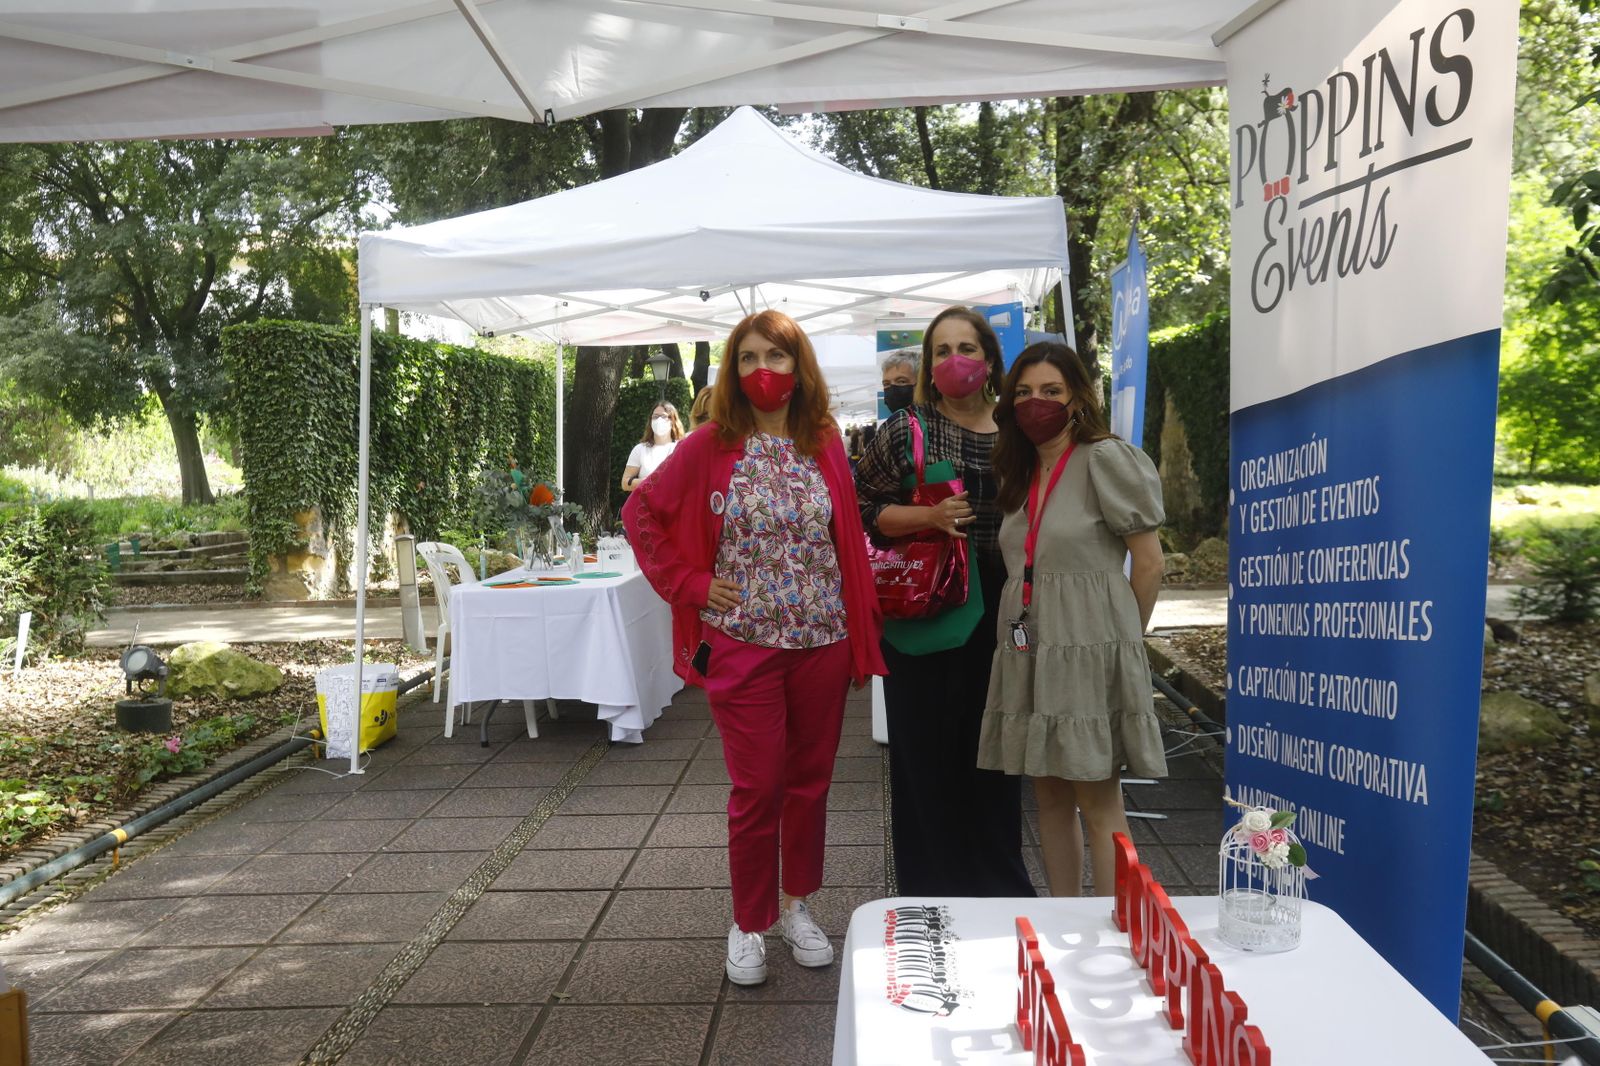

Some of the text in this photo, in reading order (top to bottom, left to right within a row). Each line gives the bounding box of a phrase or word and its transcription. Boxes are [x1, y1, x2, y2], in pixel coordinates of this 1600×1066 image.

[1235, 8, 1476, 209] POPPINS
[1250, 162, 1398, 314] Events
[1240, 432, 1328, 492] ORGANIZACIÓN
[1239, 475, 1380, 534] Y GESTIÓN DE EVENTOS
[1239, 538, 1410, 588] GESTIÓN DE CONFERENCIAS
[1238, 600, 1433, 642] Y PONENCIAS PROFESIONALES
[1238, 662, 1398, 720] CAPTACIÓN DE PATROCINIO
[1238, 722, 1429, 806] DISEÑO IMAGEN CORPORATIVA
[1301, 806, 1346, 855] ONLINE
